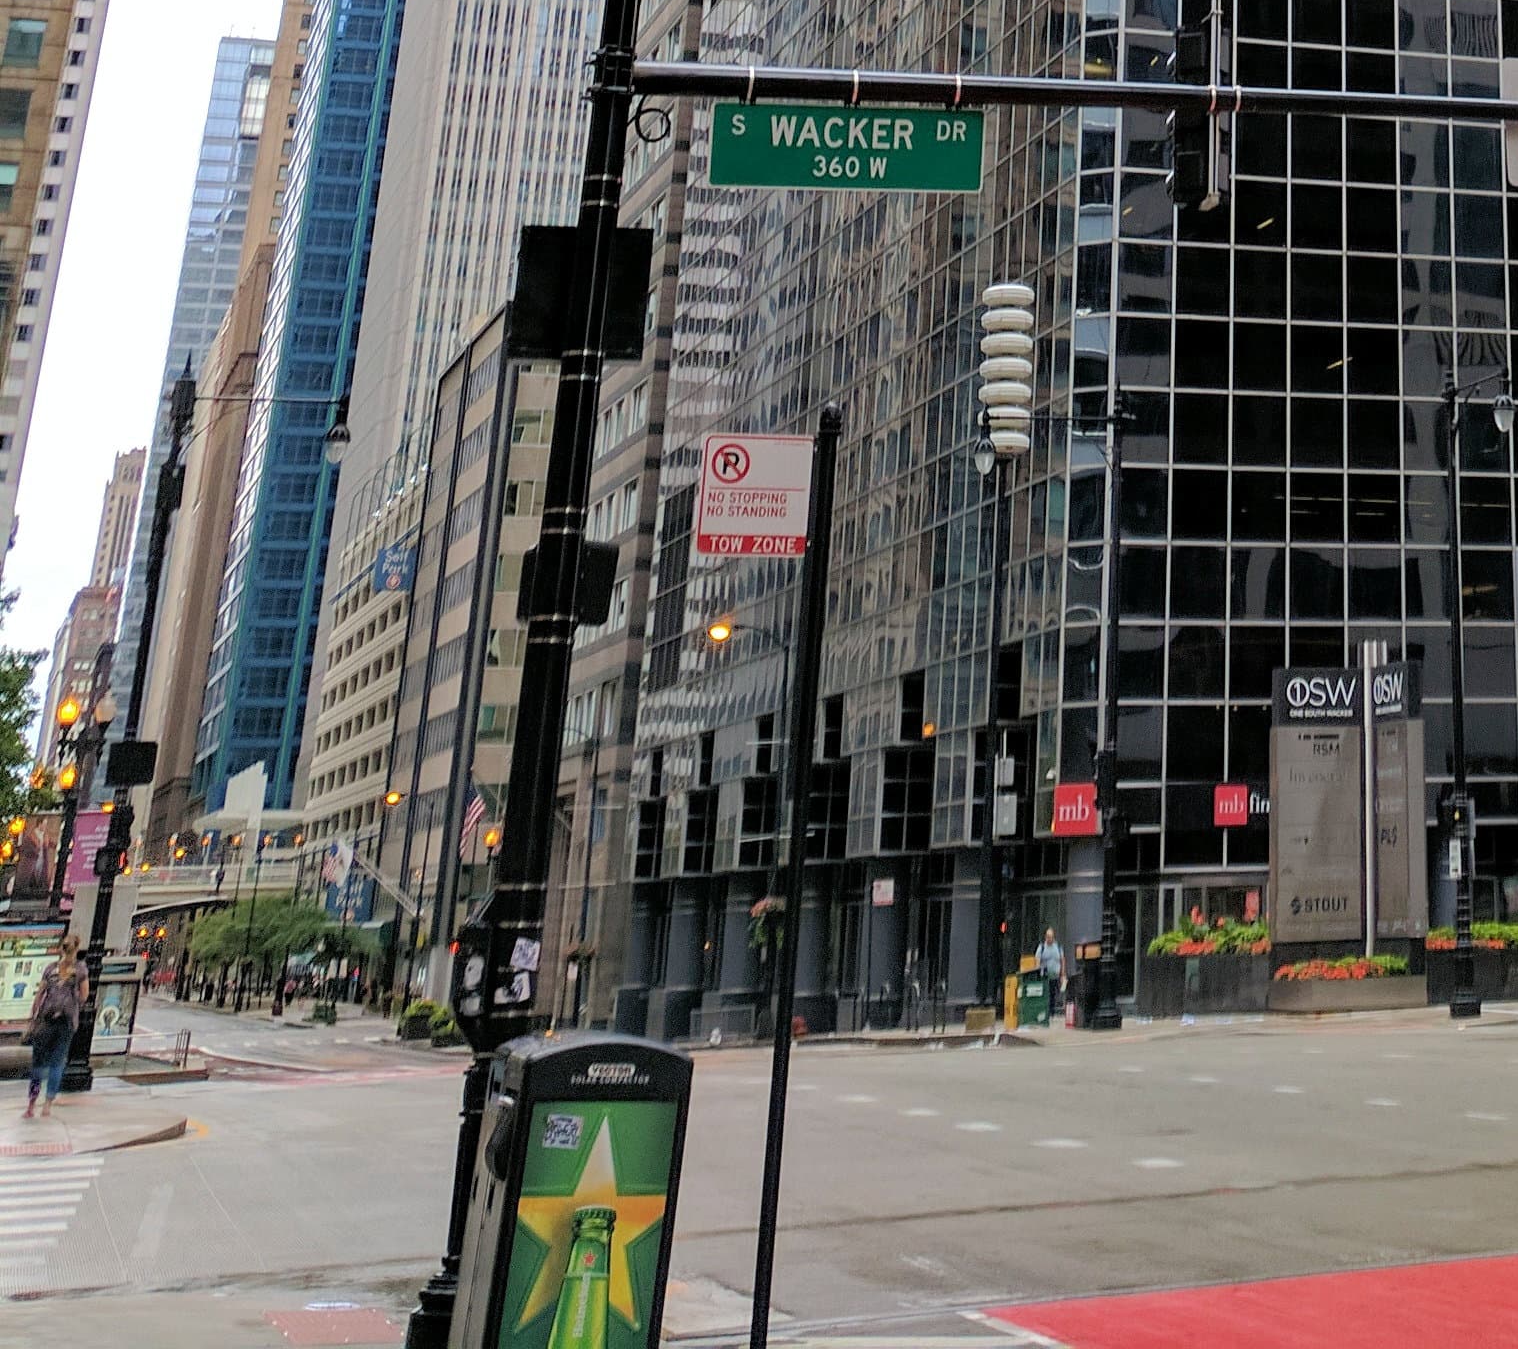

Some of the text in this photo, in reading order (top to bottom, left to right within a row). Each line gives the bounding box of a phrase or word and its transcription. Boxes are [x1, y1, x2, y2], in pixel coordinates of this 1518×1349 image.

[731, 114, 967, 150] S WACKER DR
[812, 155, 887, 179] 360 W
[708, 492, 788, 504] NO STOPPING
[706, 506, 788, 518] NO STANDING
[709, 536, 797, 553] TOW ZONE
[1059, 794, 1089, 821] mb
[1219, 794, 1244, 813] mb
[1304, 897, 1348, 912] STOUT
